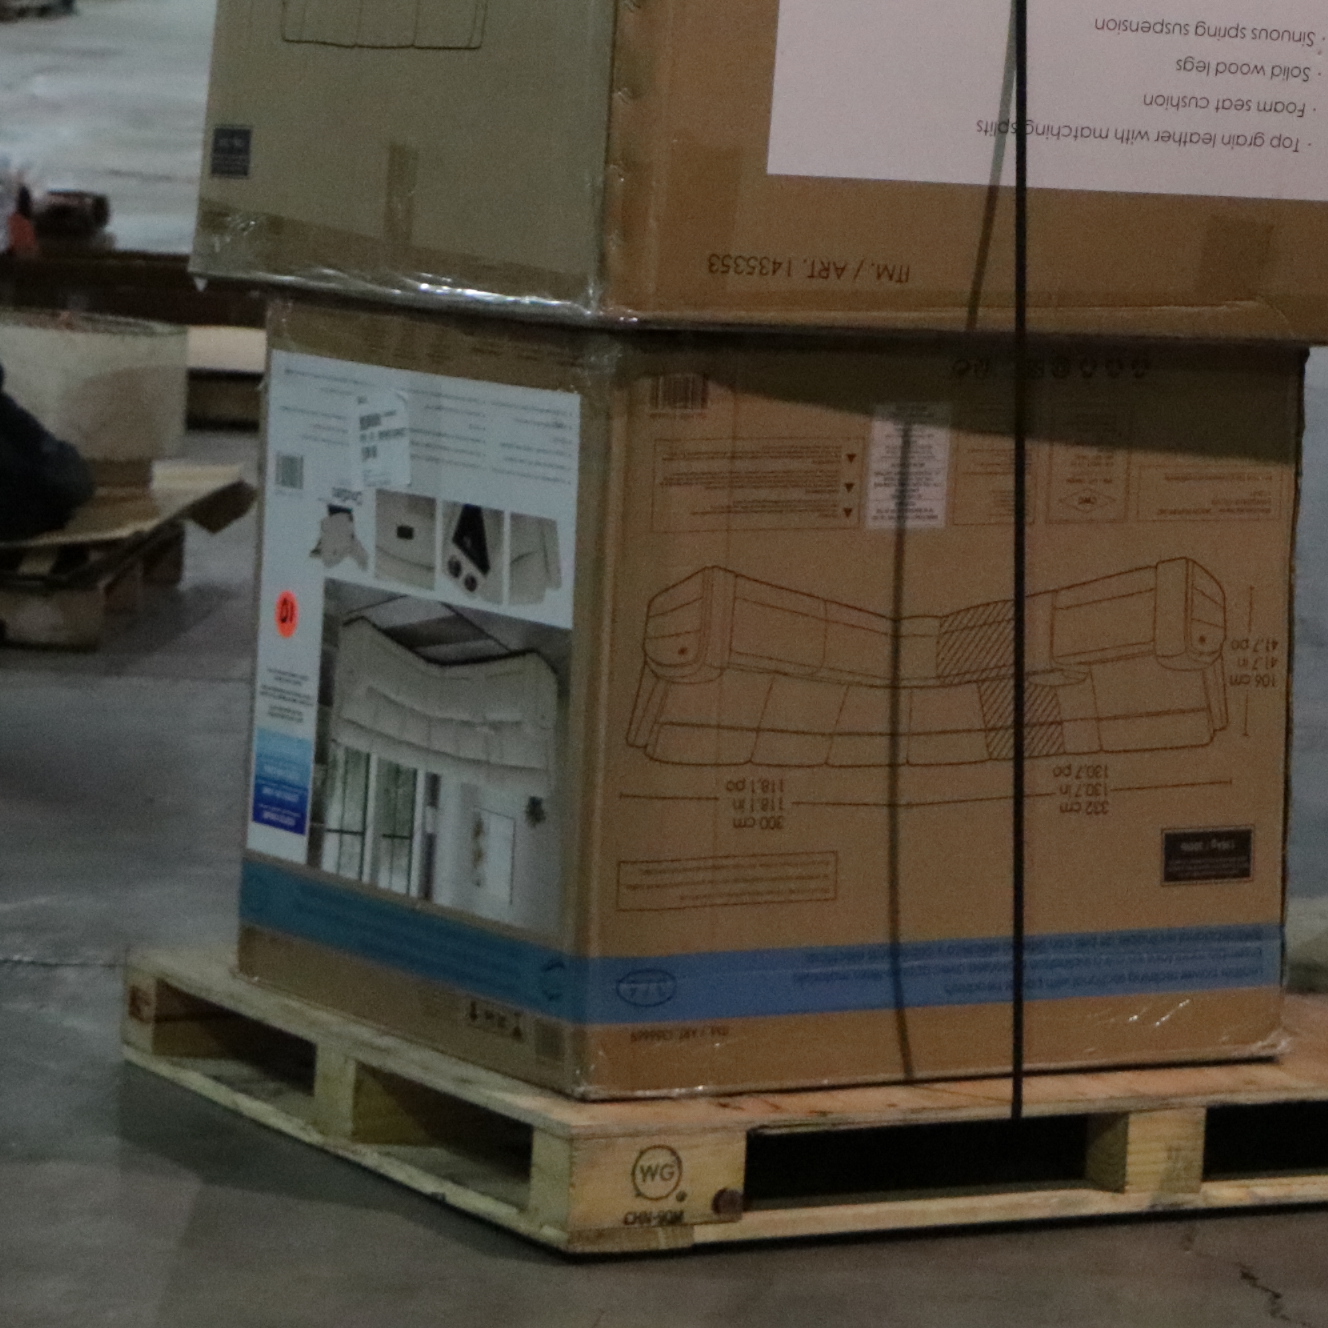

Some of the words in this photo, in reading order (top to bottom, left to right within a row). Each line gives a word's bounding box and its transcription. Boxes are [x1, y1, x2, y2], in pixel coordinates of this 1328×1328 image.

[1095, 16, 1189, 40] suspension
[1195, 21, 1246, 42] spring
[1251, 26, 1315, 47] Sinuous
[1175, 56, 1210, 76] legs
[1216, 61, 1265, 78] wood
[1271, 63, 1310, 81] Solid
[1144, 93, 1209, 112] cushion
[1215, 98, 1252, 113] seat
[1258, 98, 1305, 116] Foam
[1115, 127, 1148, 146] with
[1155, 127, 1217, 148] leather
[1222, 131, 1264, 148] grain
[1269, 131, 1300, 152] Top
[708, 254, 792, 277] 1435353
[803, 259, 847, 279] ART.
[853, 259, 865, 281] /
[871, 263, 909, 283] ITM.
[1229, 674, 1251, 686] cm
[1254, 674, 1276, 688] 106
[1059, 784, 1072, 799] in
[1074, 783, 1110, 798] 130.7
[732, 798, 745, 812] in
[751, 797, 784, 812] 118.1
[1059, 802, 1082, 814] cm
[1085, 801, 1110, 816] 332
[732, 818, 756, 829] cm
[759, 816, 784, 830] 300
[639, 1162, 675, 1184] WG
